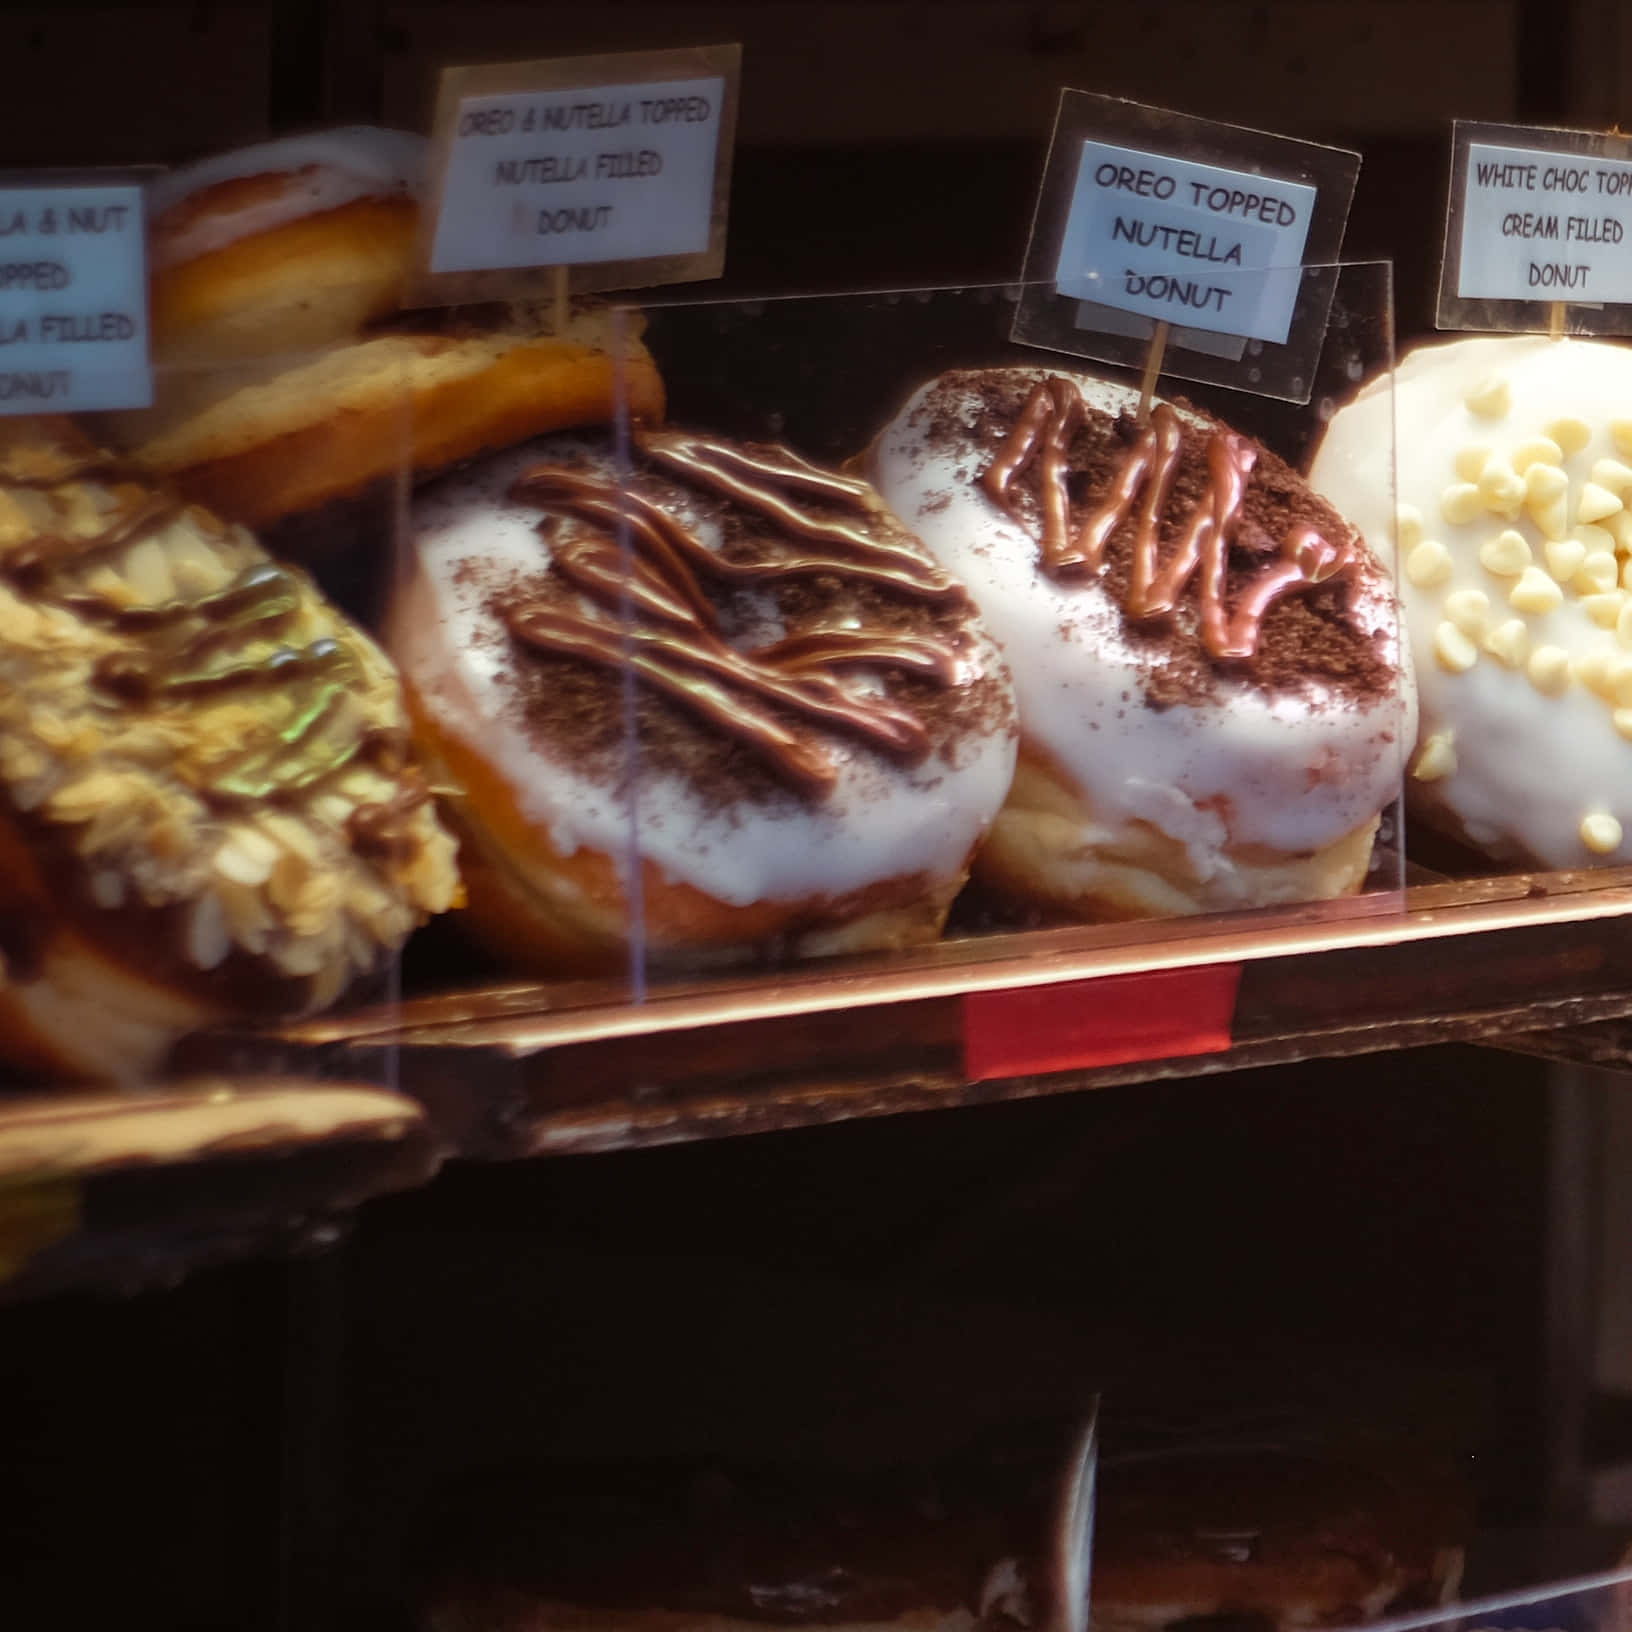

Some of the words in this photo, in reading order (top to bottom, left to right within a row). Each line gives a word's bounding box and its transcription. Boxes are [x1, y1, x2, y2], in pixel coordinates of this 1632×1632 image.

[458, 109, 513, 136] OREO
[544, 103, 633, 131] NUTELLA
[639, 96, 711, 125] TOPPED
[495, 156, 586, 186] NUTELLA
[596, 150, 662, 179] FILLED
[1477, 163, 1538, 190] WHITE
[1543, 168, 1589, 193] CHOC
[1095, 164, 1175, 199] OREO
[1190, 181, 1296, 226] TOPPED
[68, 205, 128, 233] NUT
[536, 205, 613, 236] DONUT
[1502, 213, 1559, 240] CREAM
[1566, 216, 1623, 243] FILLED
[1112, 216, 1242, 265] NUTELLA
[1125, 270, 1232, 312] DONUT
[1528, 263, 1591, 288] DONUT
[41, 313, 134, 343] FILLED
